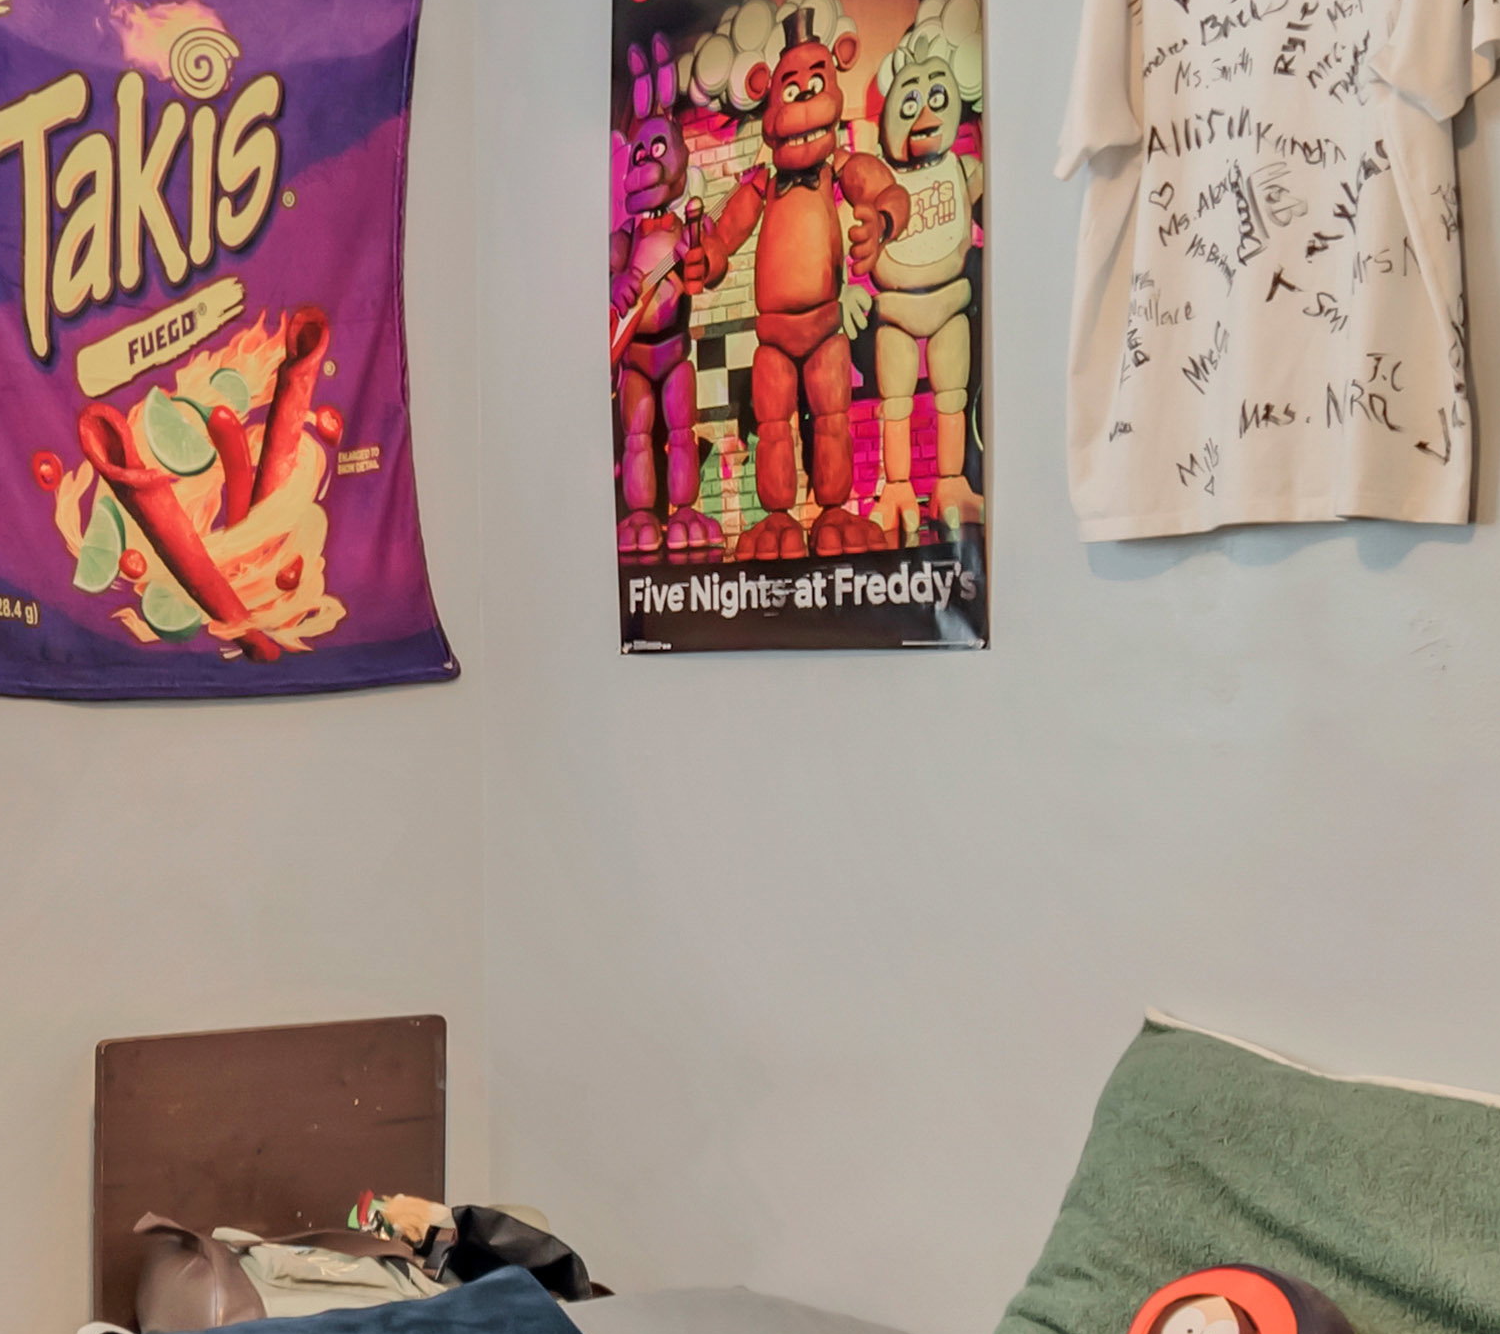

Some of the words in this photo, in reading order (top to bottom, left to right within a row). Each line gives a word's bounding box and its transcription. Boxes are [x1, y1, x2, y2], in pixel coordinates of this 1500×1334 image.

[127, 310, 198, 366] FUEGO
[24, 601, 39, 625] g)
[628, 575, 686, 615] Five
[690, 571, 788, 619] Nights
[793, 572, 828, 610] at
[834, 561, 976, 611] Freddy's
